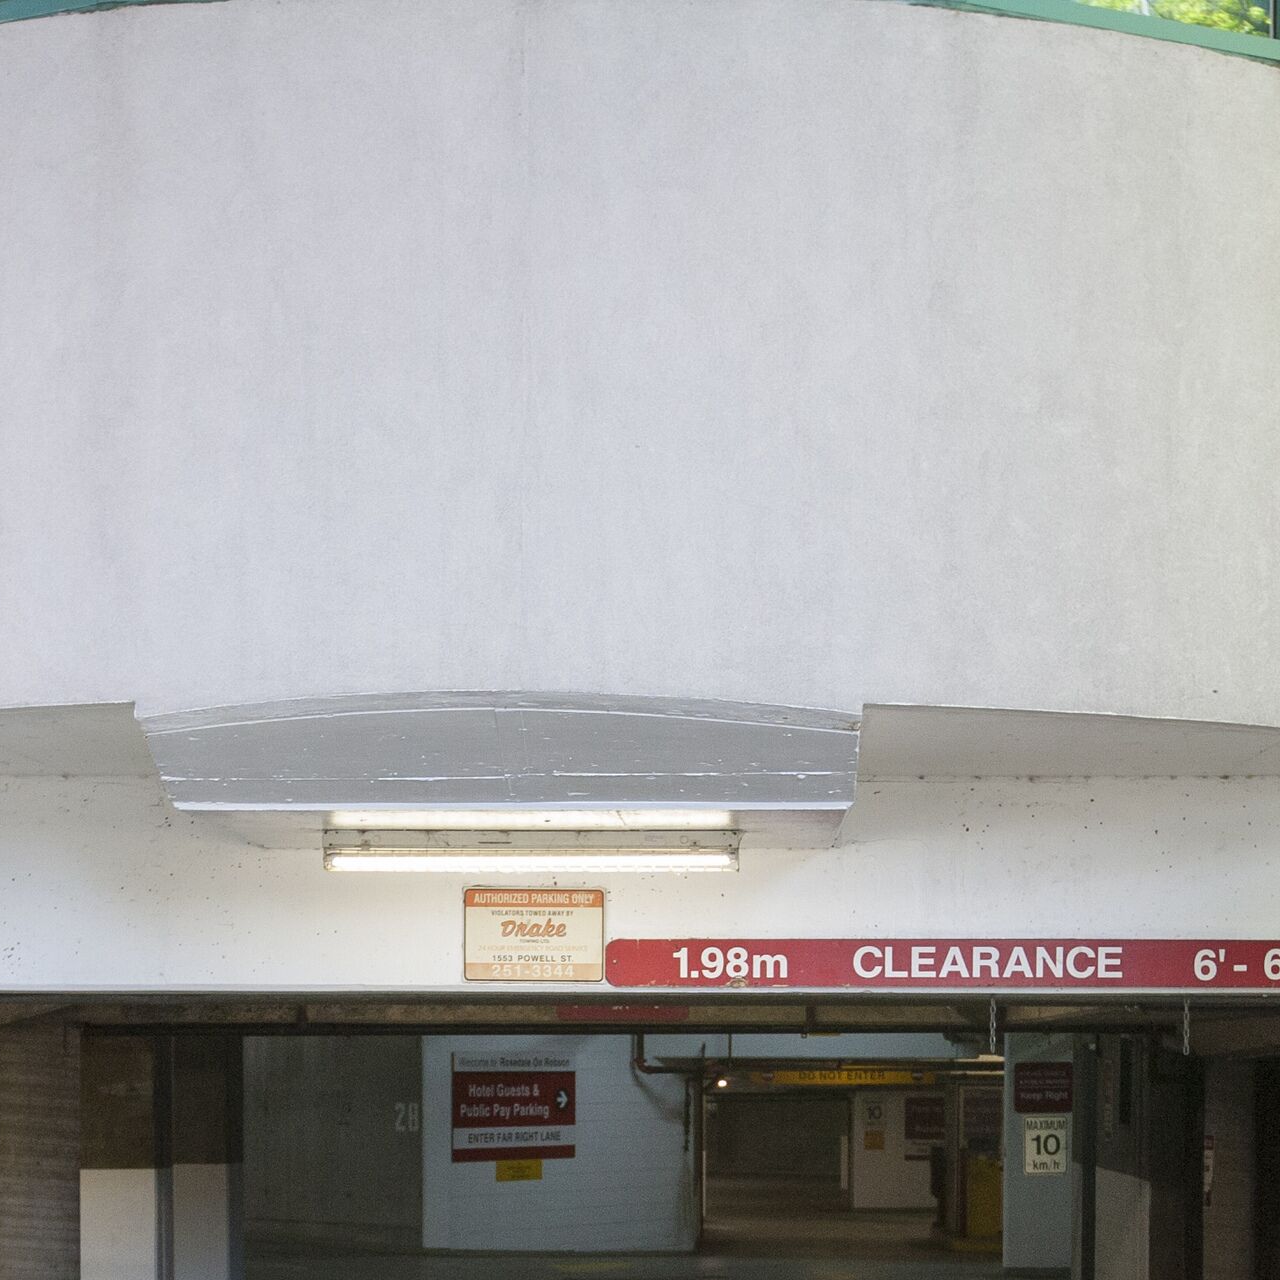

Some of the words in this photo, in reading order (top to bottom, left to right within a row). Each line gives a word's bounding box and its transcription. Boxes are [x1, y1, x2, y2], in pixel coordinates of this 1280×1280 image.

[474, 893, 528, 904] AUTHORIZED
[531, 893, 569, 904] PARKING
[571, 893, 595, 904] ONLY
[500, 918, 567, 938] Drake
[673, 948, 788, 979] 1.98m
[852, 946, 1123, 980] CLEARANCE
[492, 964, 574, 978] 251-3344
[799, 1071, 815, 1080] DO
[820, 1071, 842, 1080] NOT
[848, 1071, 885, 1080] ENTER
[468, 1085, 494, 1097] Hotel
[496, 1084, 530, 1097] Guests
[532, 1084, 540, 1097] &
[1045, 1091, 1068, 1101] Right
[460, 1104, 490, 1117] Public
[493, 1105, 510, 1119] Pay
[513, 1103, 549, 1119] Parking
[866, 1103, 881, 1119] 10
[1026, 1120, 1066, 1130] MAXIMUM
[468, 1133, 495, 1143] ENTER
[496, 1132, 512, 1143] FAR
[515, 1131, 538, 1142] RIGHT
[541, 1131, 561, 1141] LANE
[1031, 1134, 1060, 1155] 10
[1032, 1160, 1060, 1170] km/h
